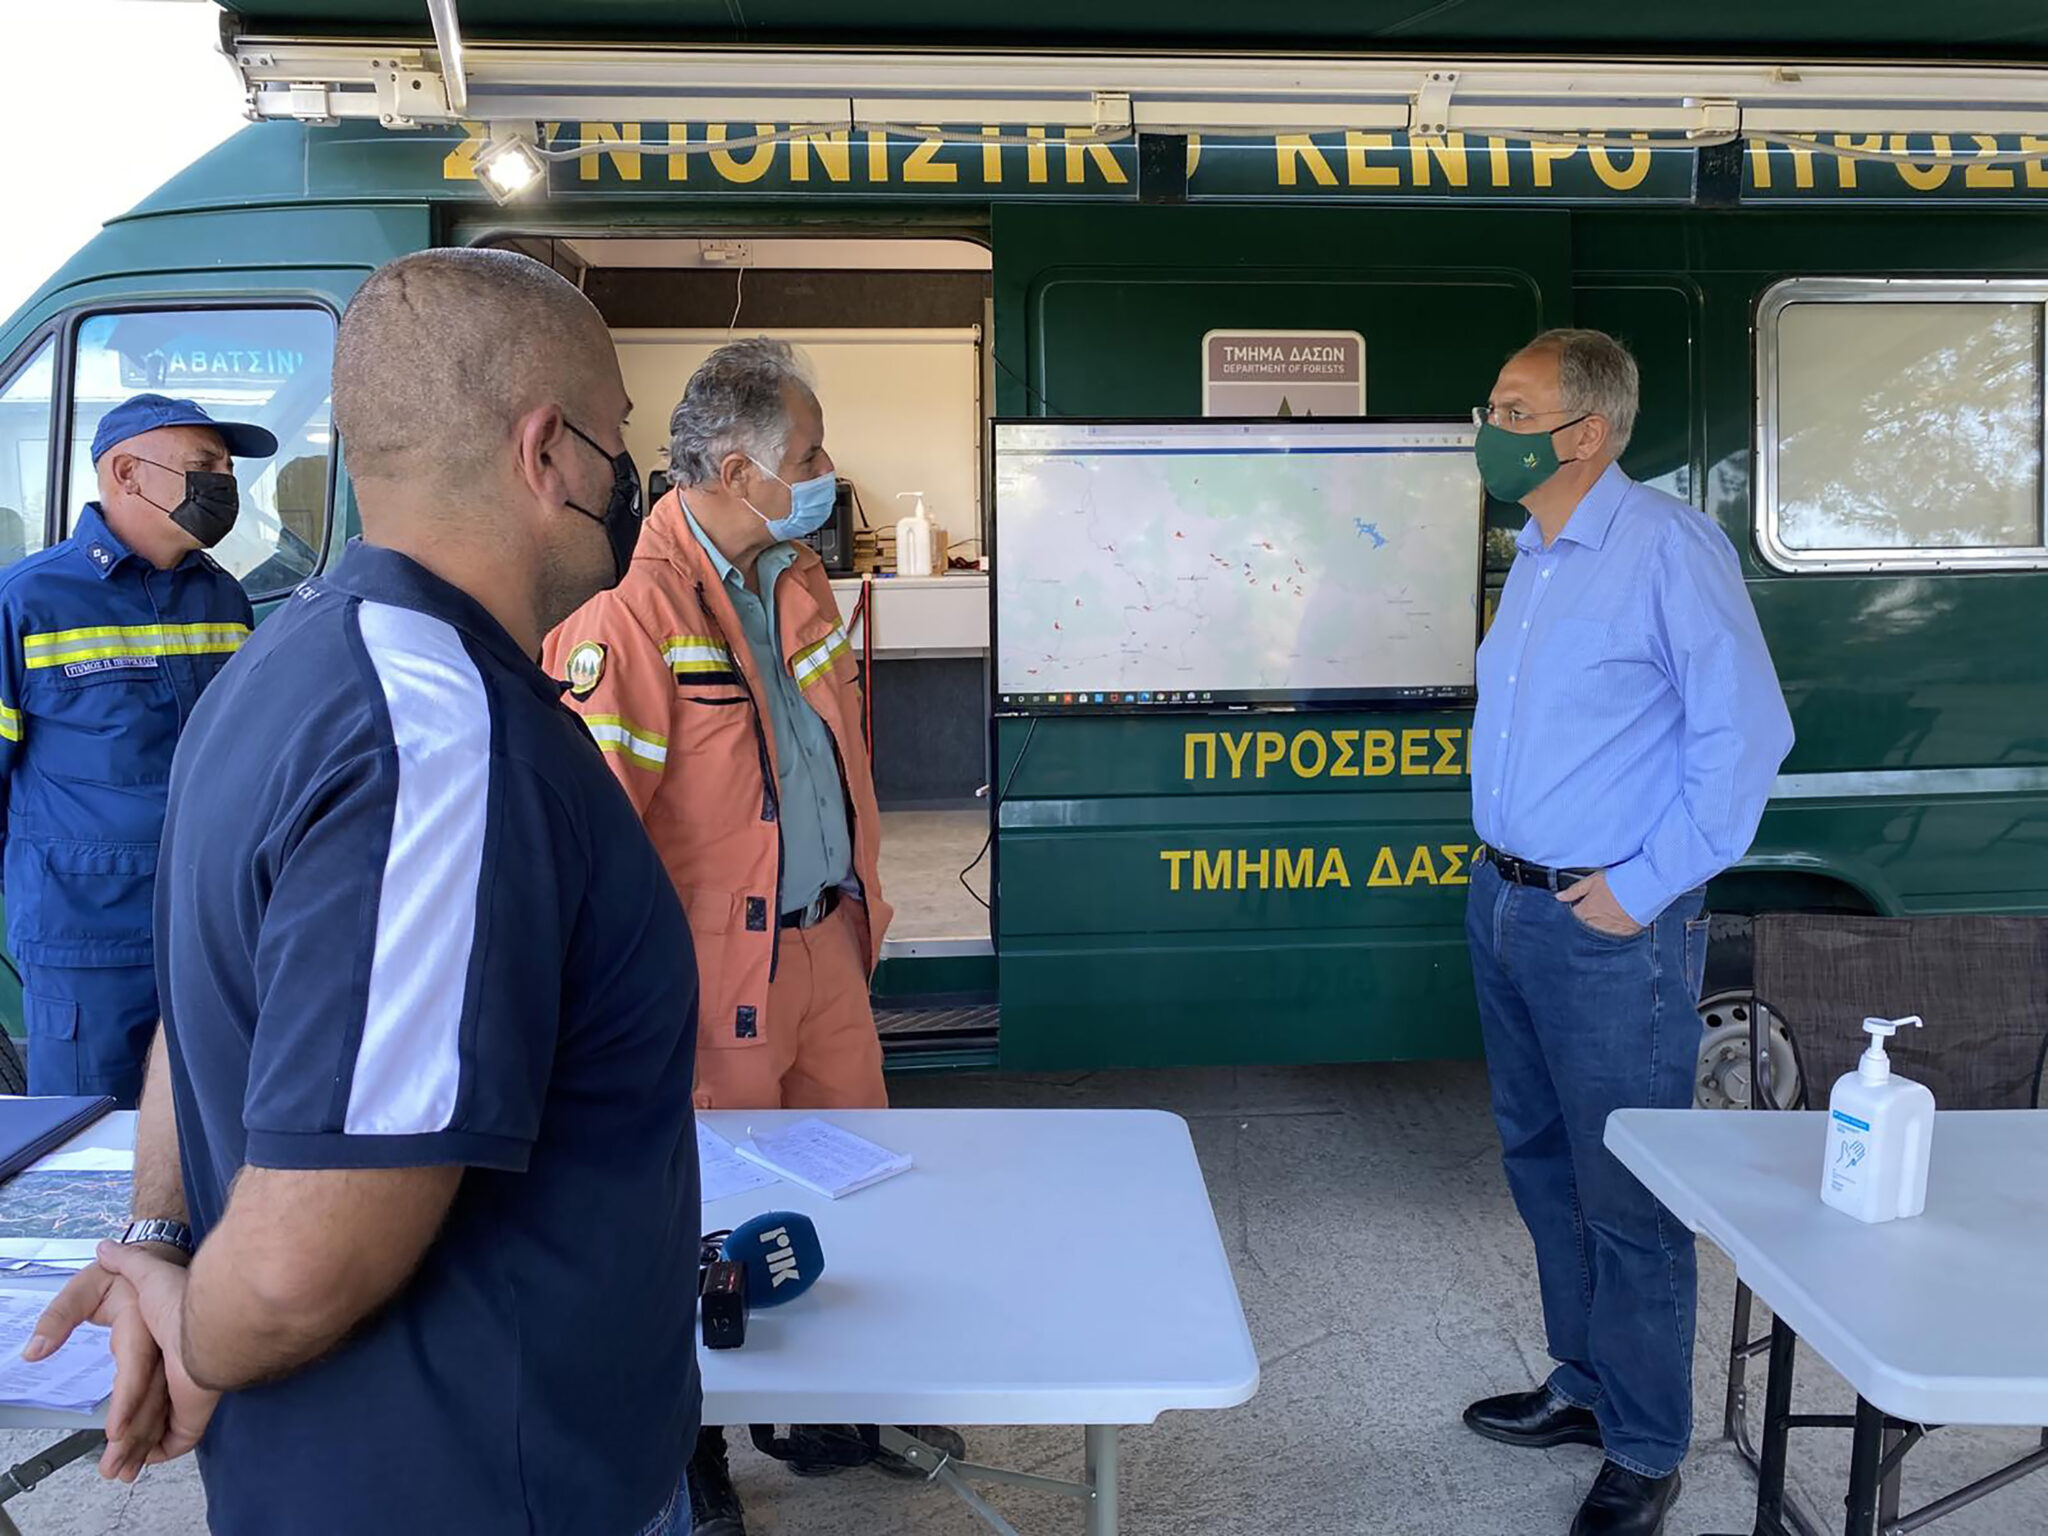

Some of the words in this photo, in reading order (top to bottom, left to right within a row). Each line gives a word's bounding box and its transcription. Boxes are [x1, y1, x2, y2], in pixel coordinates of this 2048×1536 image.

[1223, 346, 1284, 362] ΤΜΗΜΑ
[1289, 347, 1345, 362] ΔΑΣΩΝ
[1223, 364, 1286, 374] DEPARTMENT
[1288, 364, 1301, 374] OF
[1303, 364, 1345, 374] FORESTS
[1184, 729, 1473, 780] ΠΥΡΟΣΒΕΣ
[1160, 847, 1351, 890] ΤΜΗΜΑ
